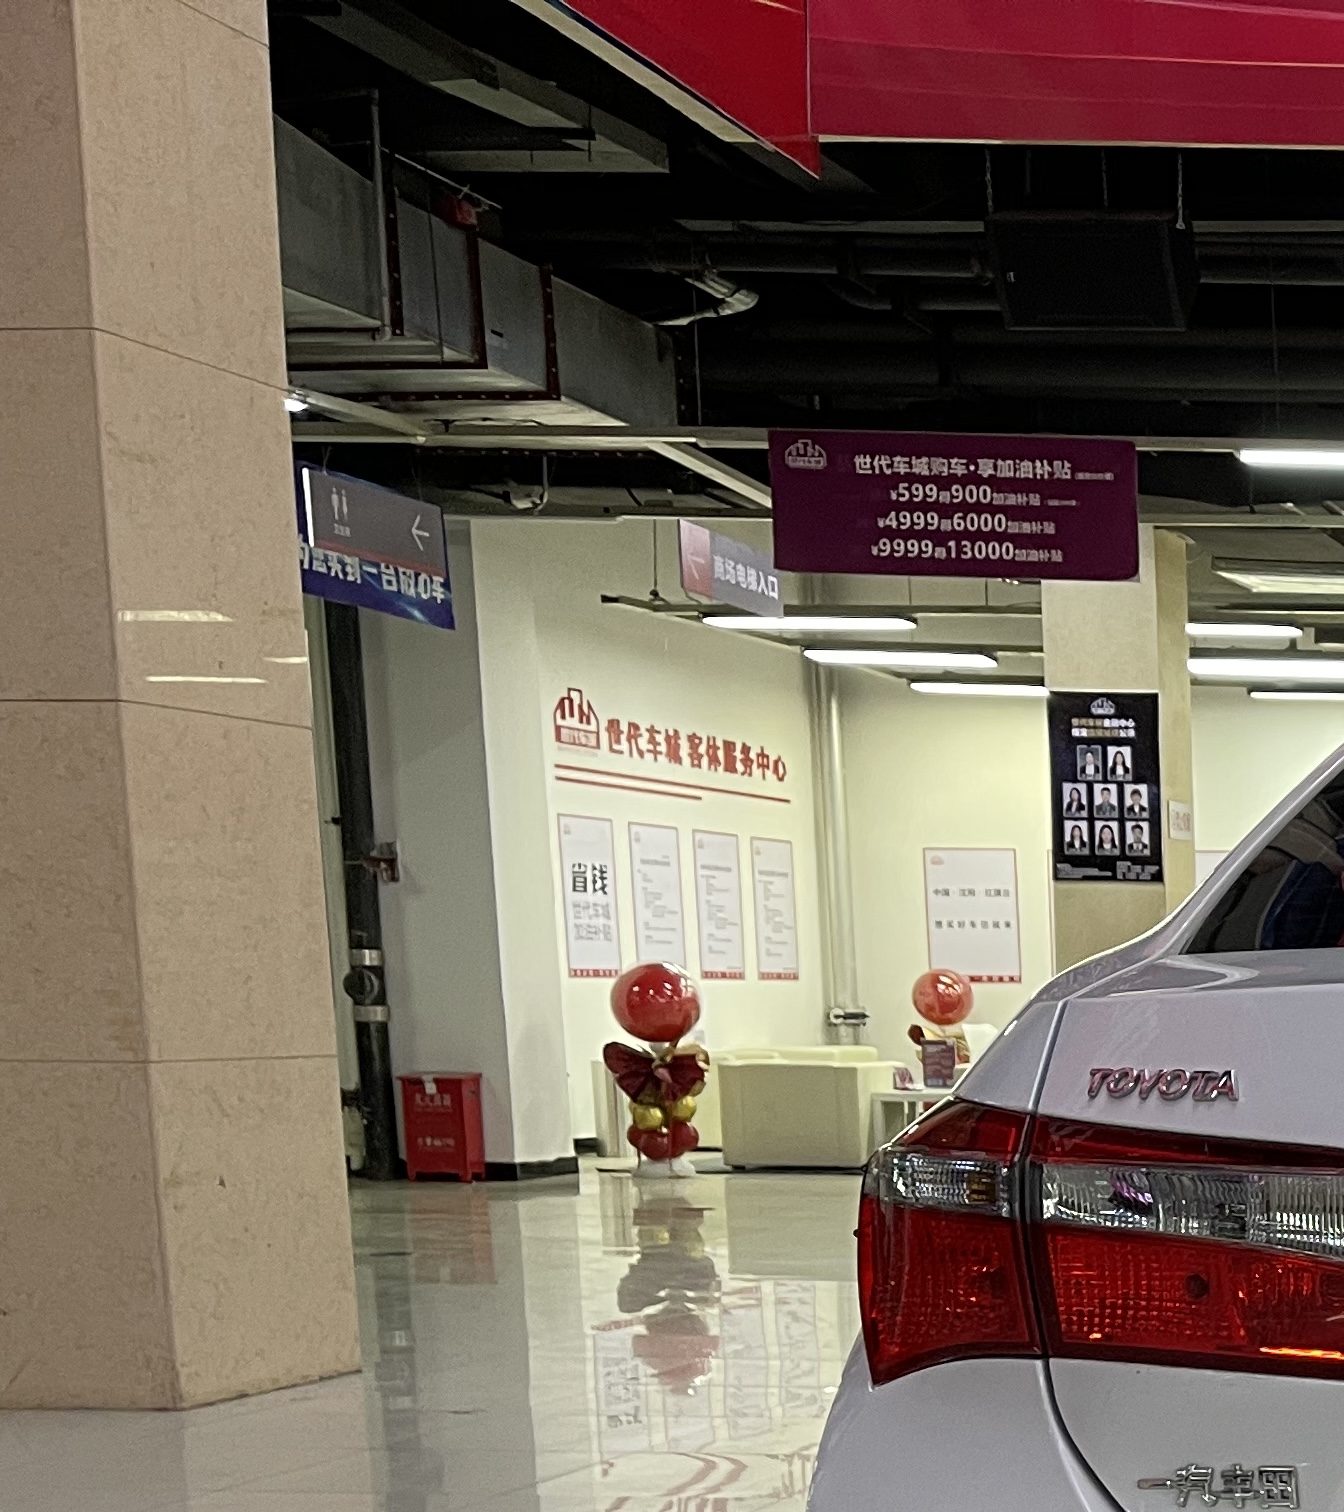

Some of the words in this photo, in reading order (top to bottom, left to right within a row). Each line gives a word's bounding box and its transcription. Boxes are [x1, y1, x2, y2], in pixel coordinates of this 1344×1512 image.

[605, 719, 682, 765] 世代车城
[571, 862, 608, 895] 省钱
[1087, 1067, 1239, 1101] TOYOTA
